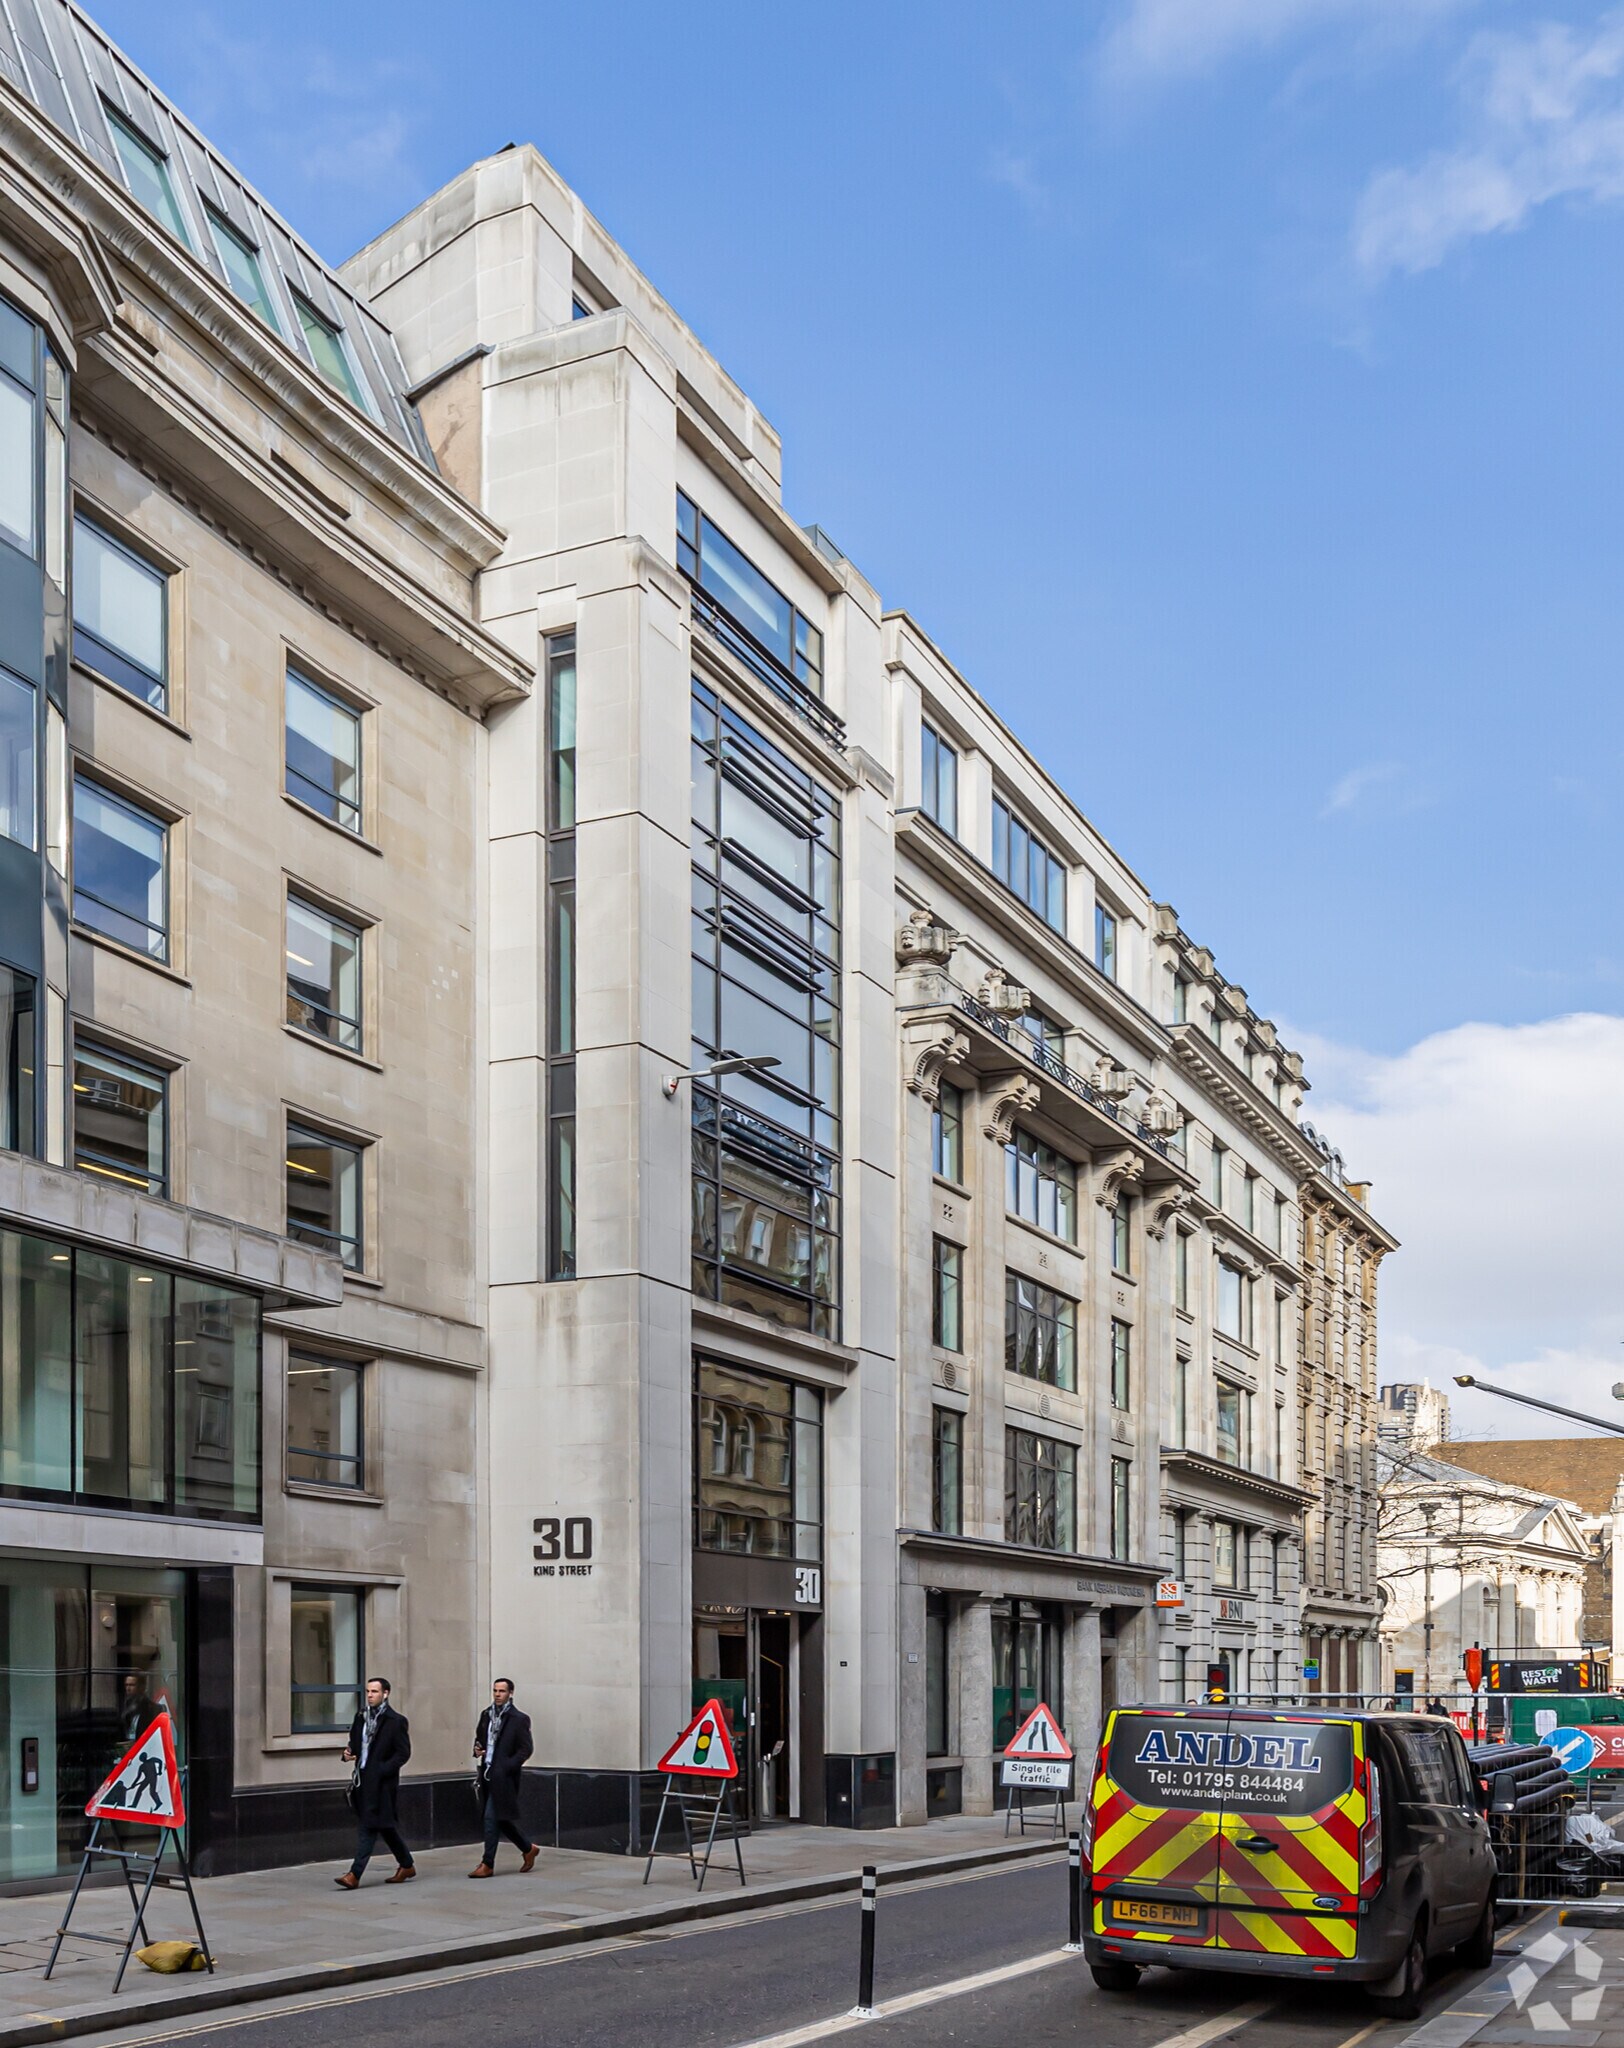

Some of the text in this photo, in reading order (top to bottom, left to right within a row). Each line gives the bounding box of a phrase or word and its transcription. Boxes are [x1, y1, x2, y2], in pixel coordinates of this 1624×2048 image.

[533, 1517, 592, 1560] 30
[533, 1565, 593, 1577] KING STREET
[795, 1567, 820, 1604] 30
[1228, 1601, 1243, 1619] BNI
[1522, 1676, 1559, 1686] WASTE
[1135, 1729, 1321, 1773] ANDEL
[1611, 1737, 1624, 1748] C
[1011, 1763, 1062, 1774] Single file
[1020, 1773, 1051, 1783] traffic
[1148, 1769, 1305, 1792] Tel: 01795 844484
[1161, 1787, 1287, 1803] www.andelplant.co.uk
[1119, 1903, 1192, 1922] LF66 FNH
